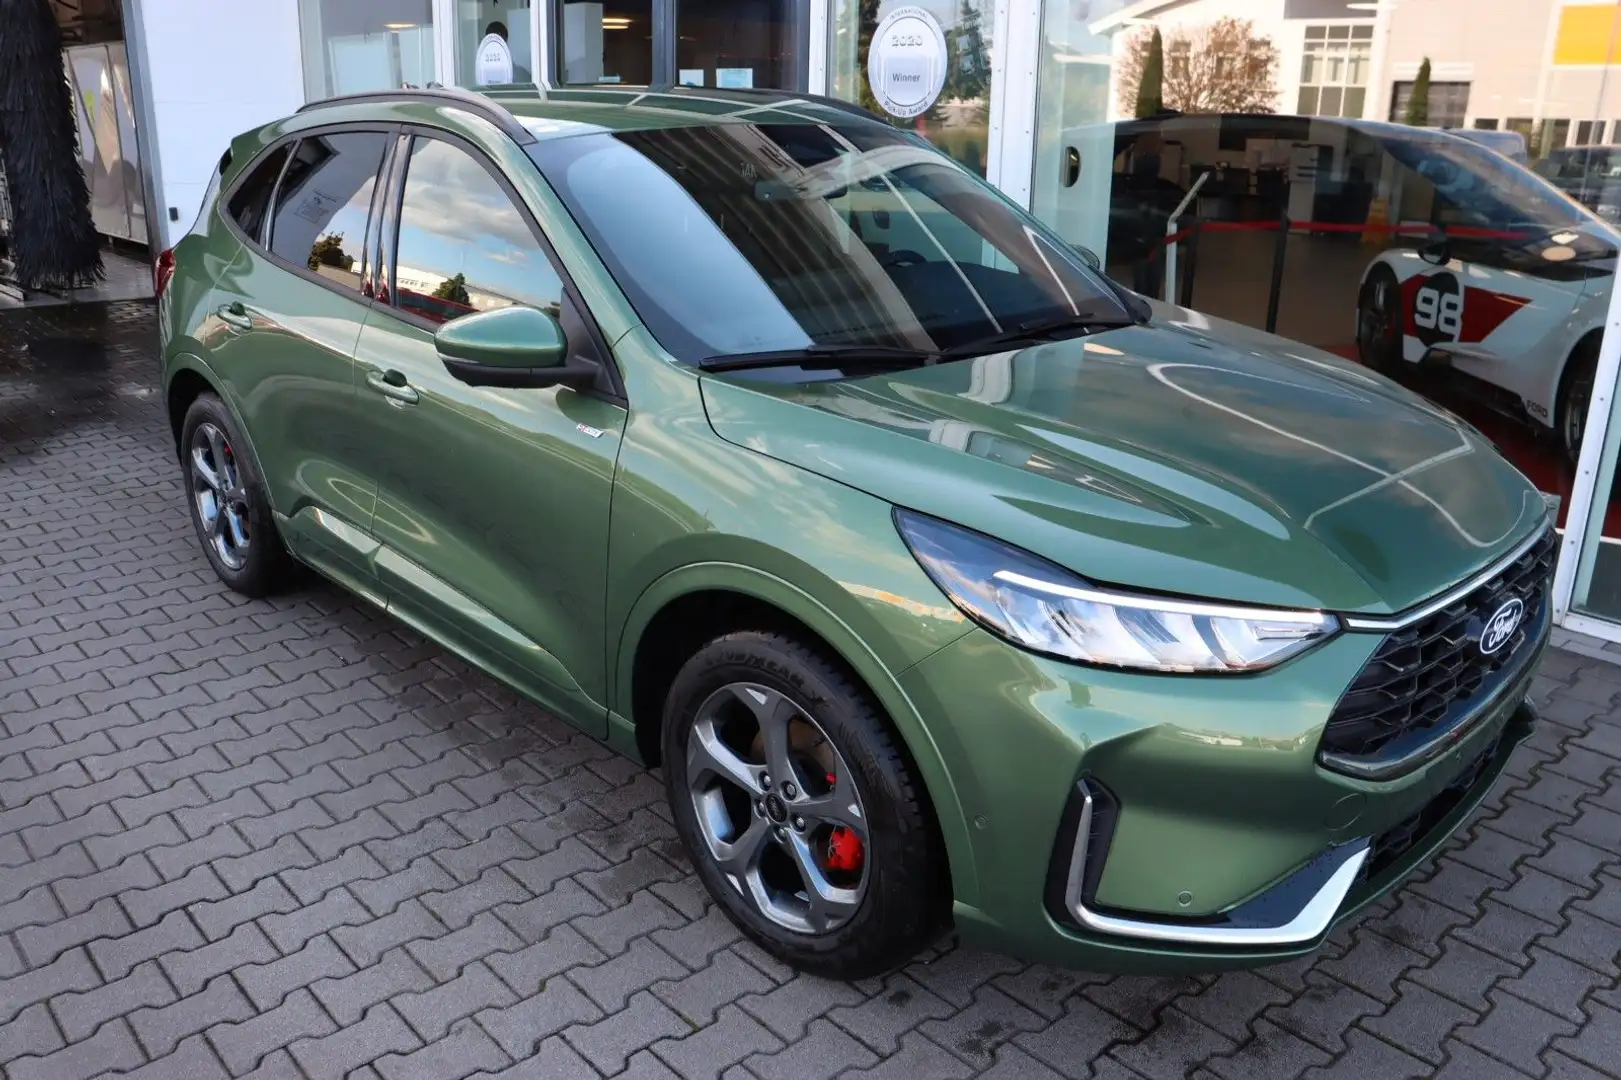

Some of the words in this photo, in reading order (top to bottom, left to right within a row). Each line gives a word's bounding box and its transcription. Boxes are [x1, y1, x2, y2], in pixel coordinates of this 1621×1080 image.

[892, 72, 921, 82] Winner
[1414, 286, 1463, 336] 98
[1487, 606, 1518, 649] Ford
